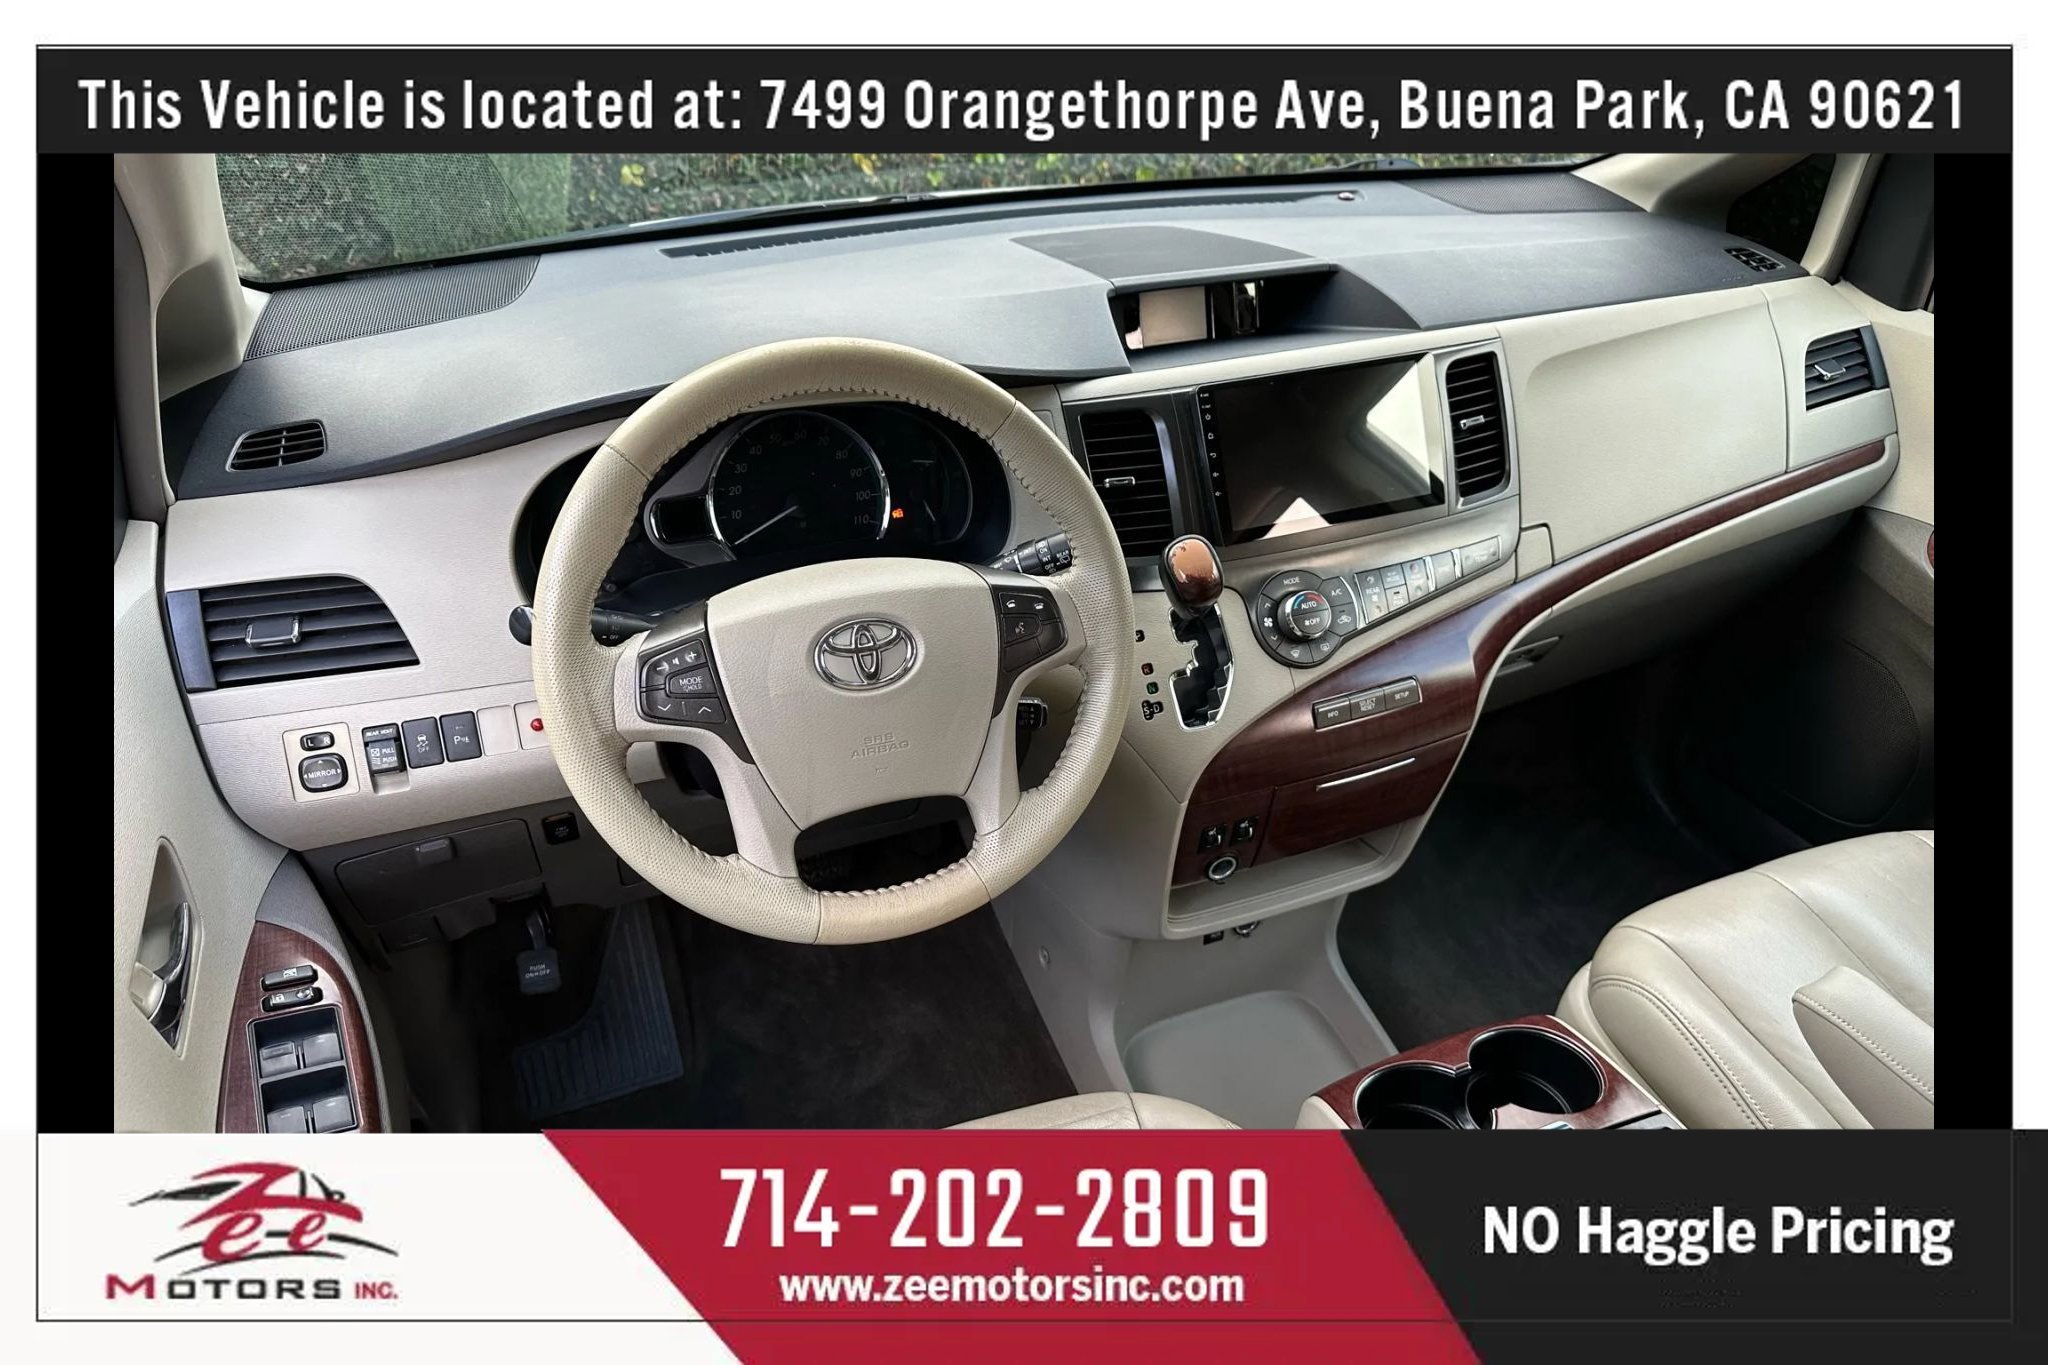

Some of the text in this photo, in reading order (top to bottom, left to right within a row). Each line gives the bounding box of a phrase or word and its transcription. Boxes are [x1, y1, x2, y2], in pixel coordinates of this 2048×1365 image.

[733, 463, 748, 474] 30
[728, 485, 742, 496] 20
[856, 489, 871, 500] 100
[731, 510, 742, 520] 10
[854, 514, 870, 525] 110
[1283, 576, 1300, 585] MODE
[1331, 588, 1342, 596] A/C
[1301, 601, 1317, 610] AUTO
[679, 675, 702, 686] MODE
[323, 736, 331, 745] R
[851, 740, 910, 760] AIRBAG
[308, 769, 337, 778] MIRROR
